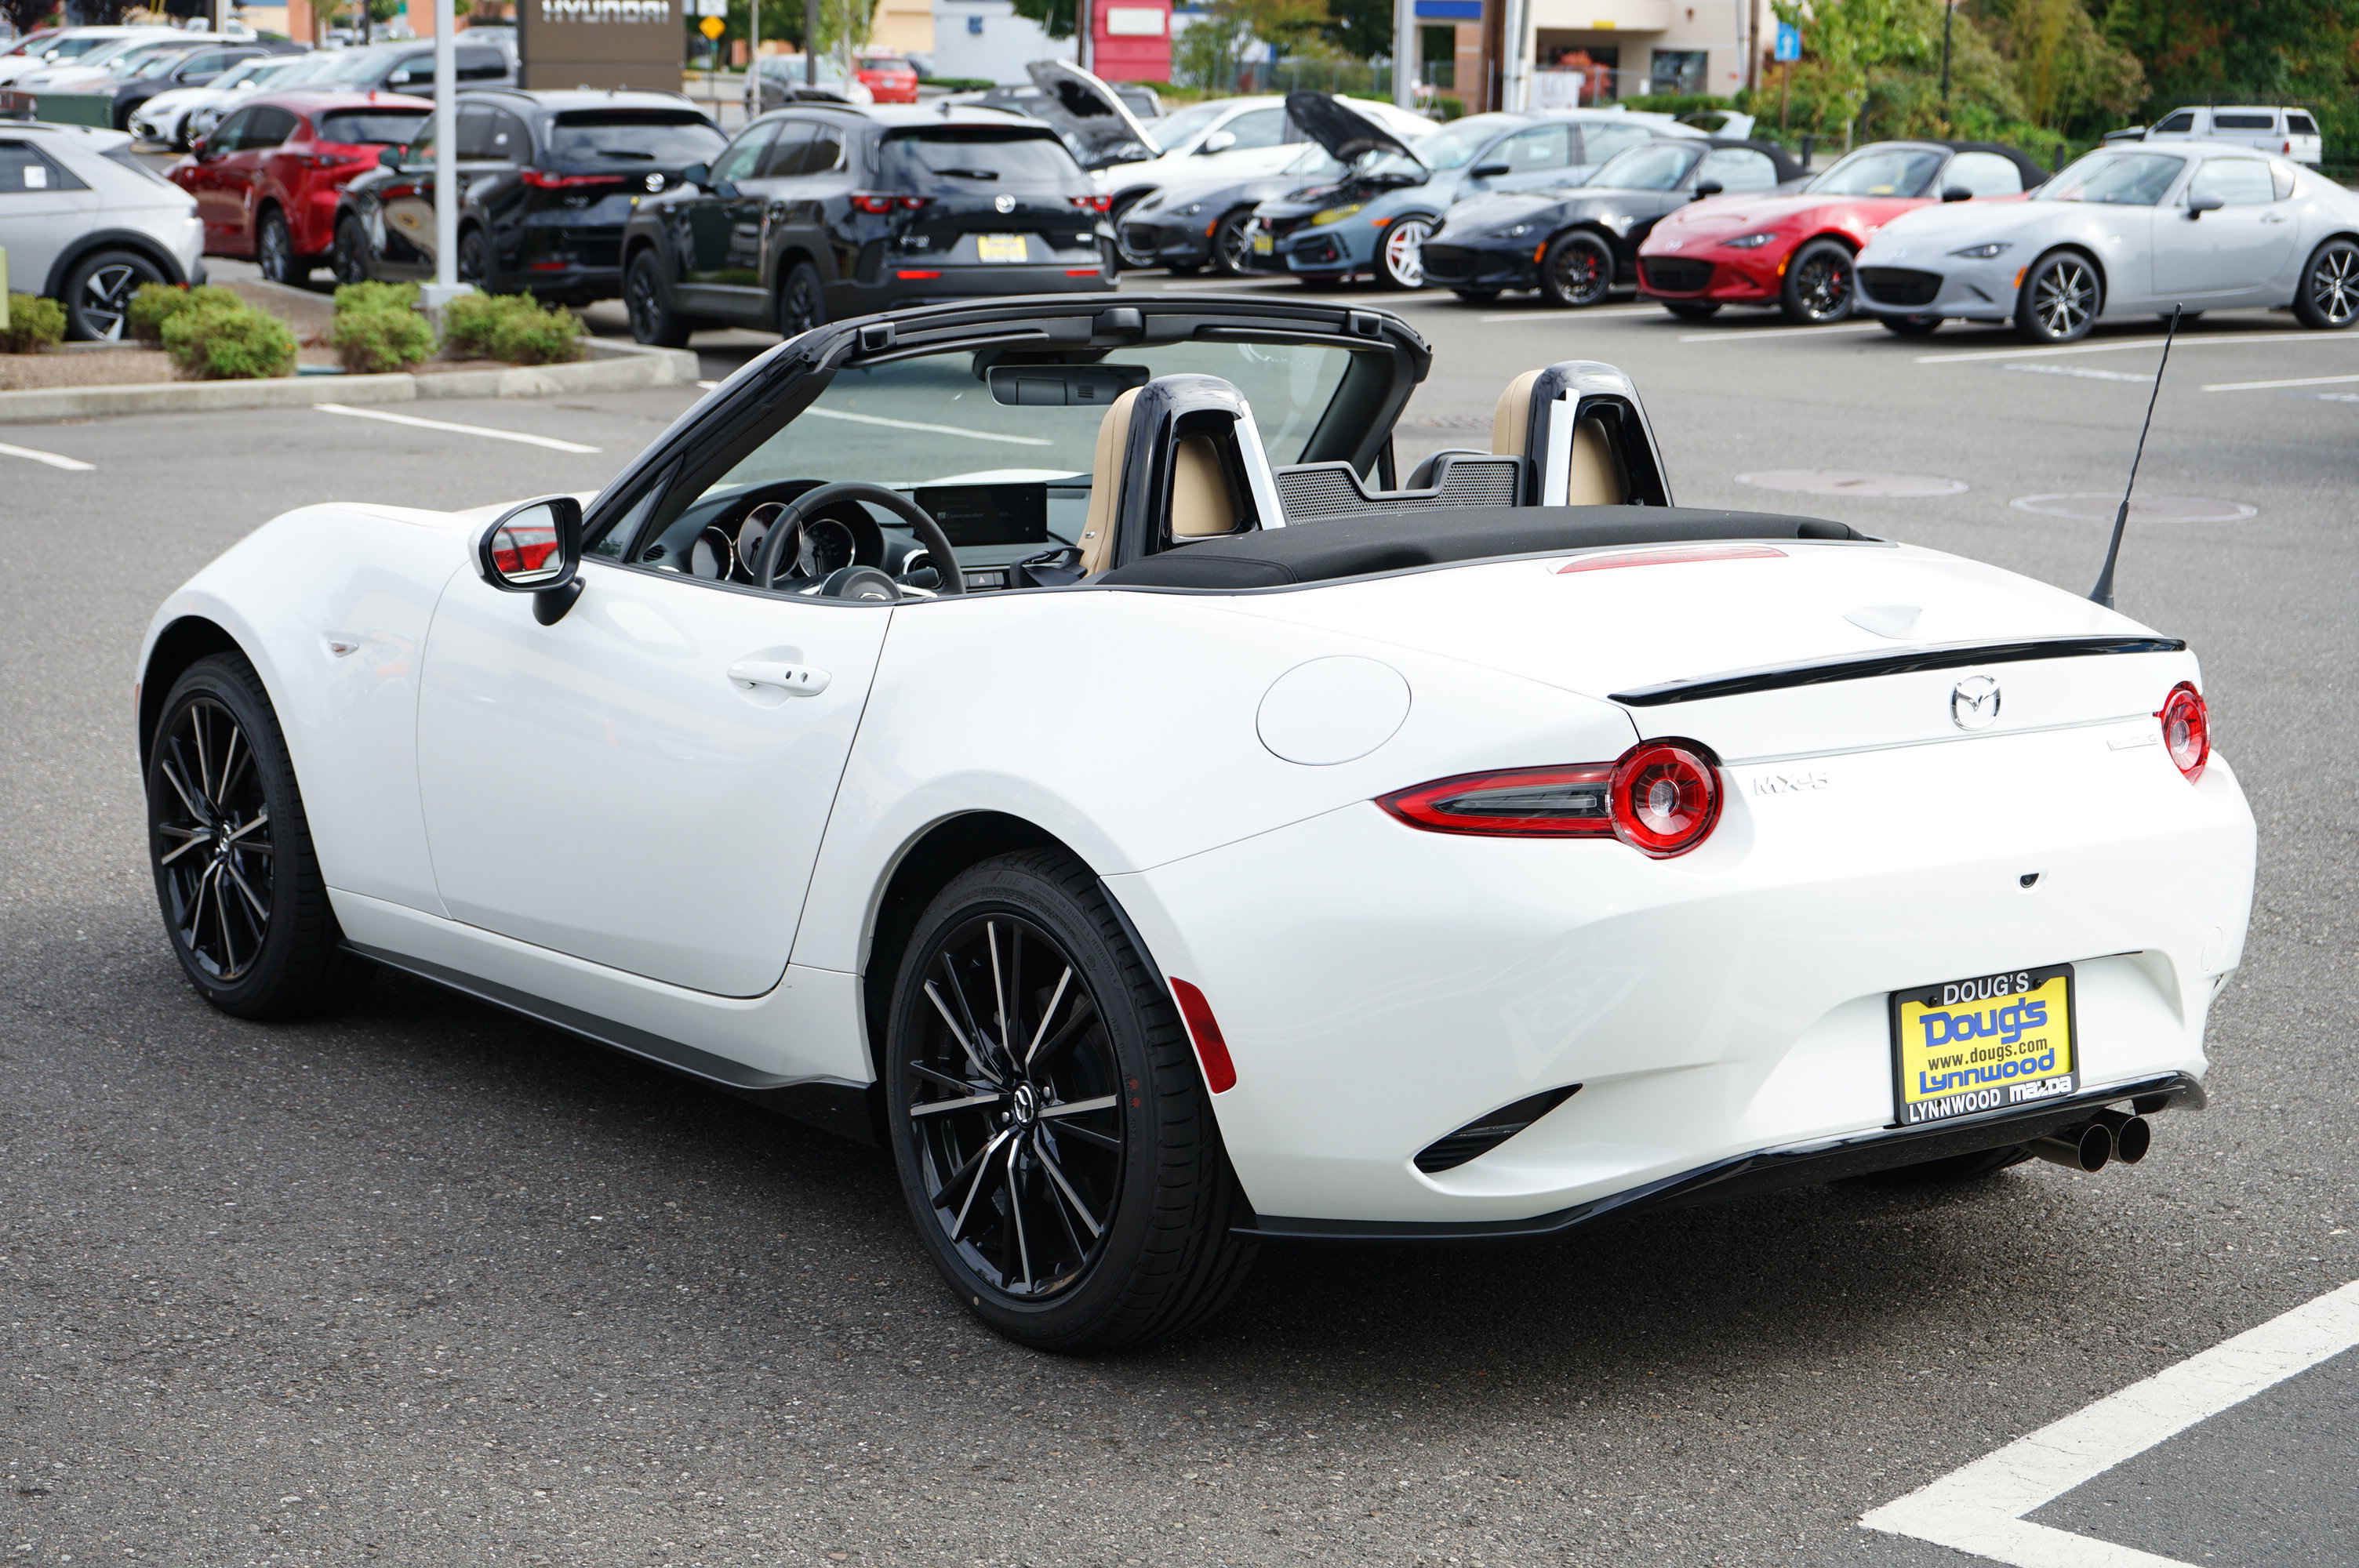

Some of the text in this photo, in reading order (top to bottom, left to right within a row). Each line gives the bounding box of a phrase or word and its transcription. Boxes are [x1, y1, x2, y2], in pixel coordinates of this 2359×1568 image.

[541, 0, 671, 24] HYUNDAI
[1943, 972, 2029, 1006] DOUG'S
[1919, 997, 2048, 1047] Doug's
[1919, 1047, 2055, 1094] Lynnwood
[1928, 1038, 2048, 1071] www.dougs.com
[1909, 1088, 2001, 1123] LYNNWOOD
